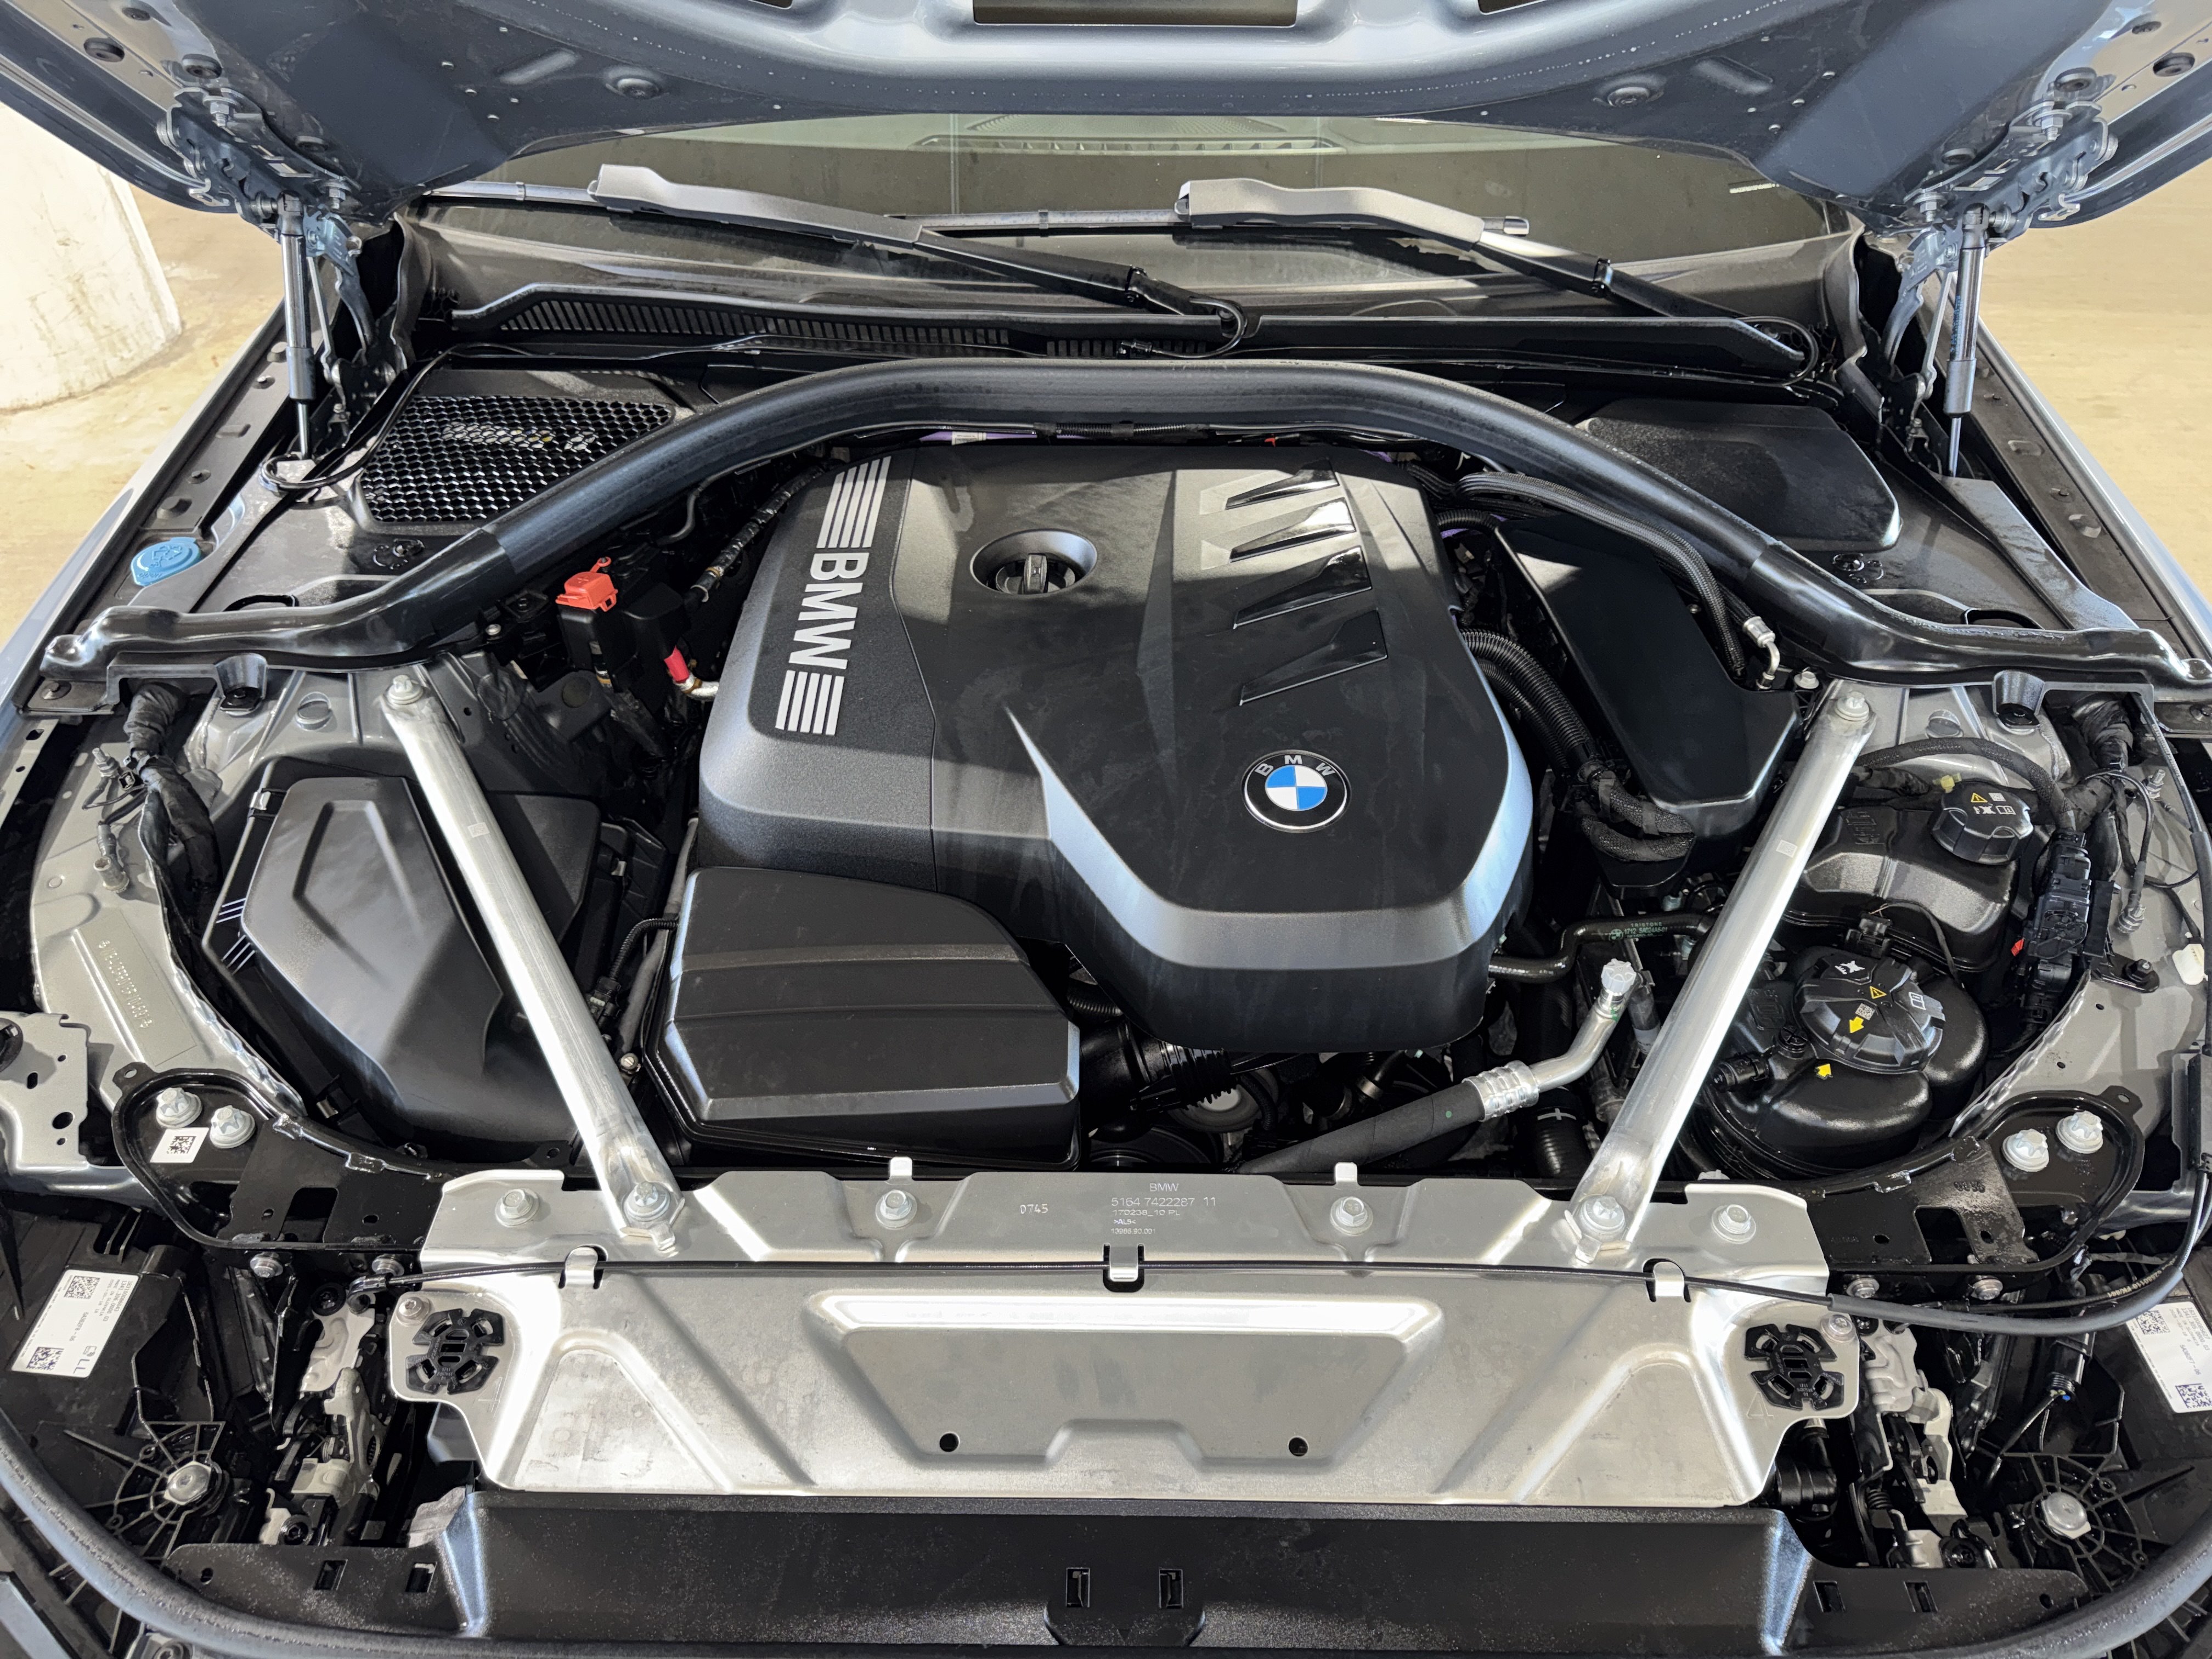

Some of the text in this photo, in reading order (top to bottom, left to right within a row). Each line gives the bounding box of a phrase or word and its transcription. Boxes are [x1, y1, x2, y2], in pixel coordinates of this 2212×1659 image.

[788, 552, 870, 669] BMW
[1254, 755, 1336, 777] BMW
[1149, 1183, 1179, 1192] BMW
[1111, 1197, 1216, 1206] 5164 7422287 11
[1019, 1204, 1048, 1214] 0745
